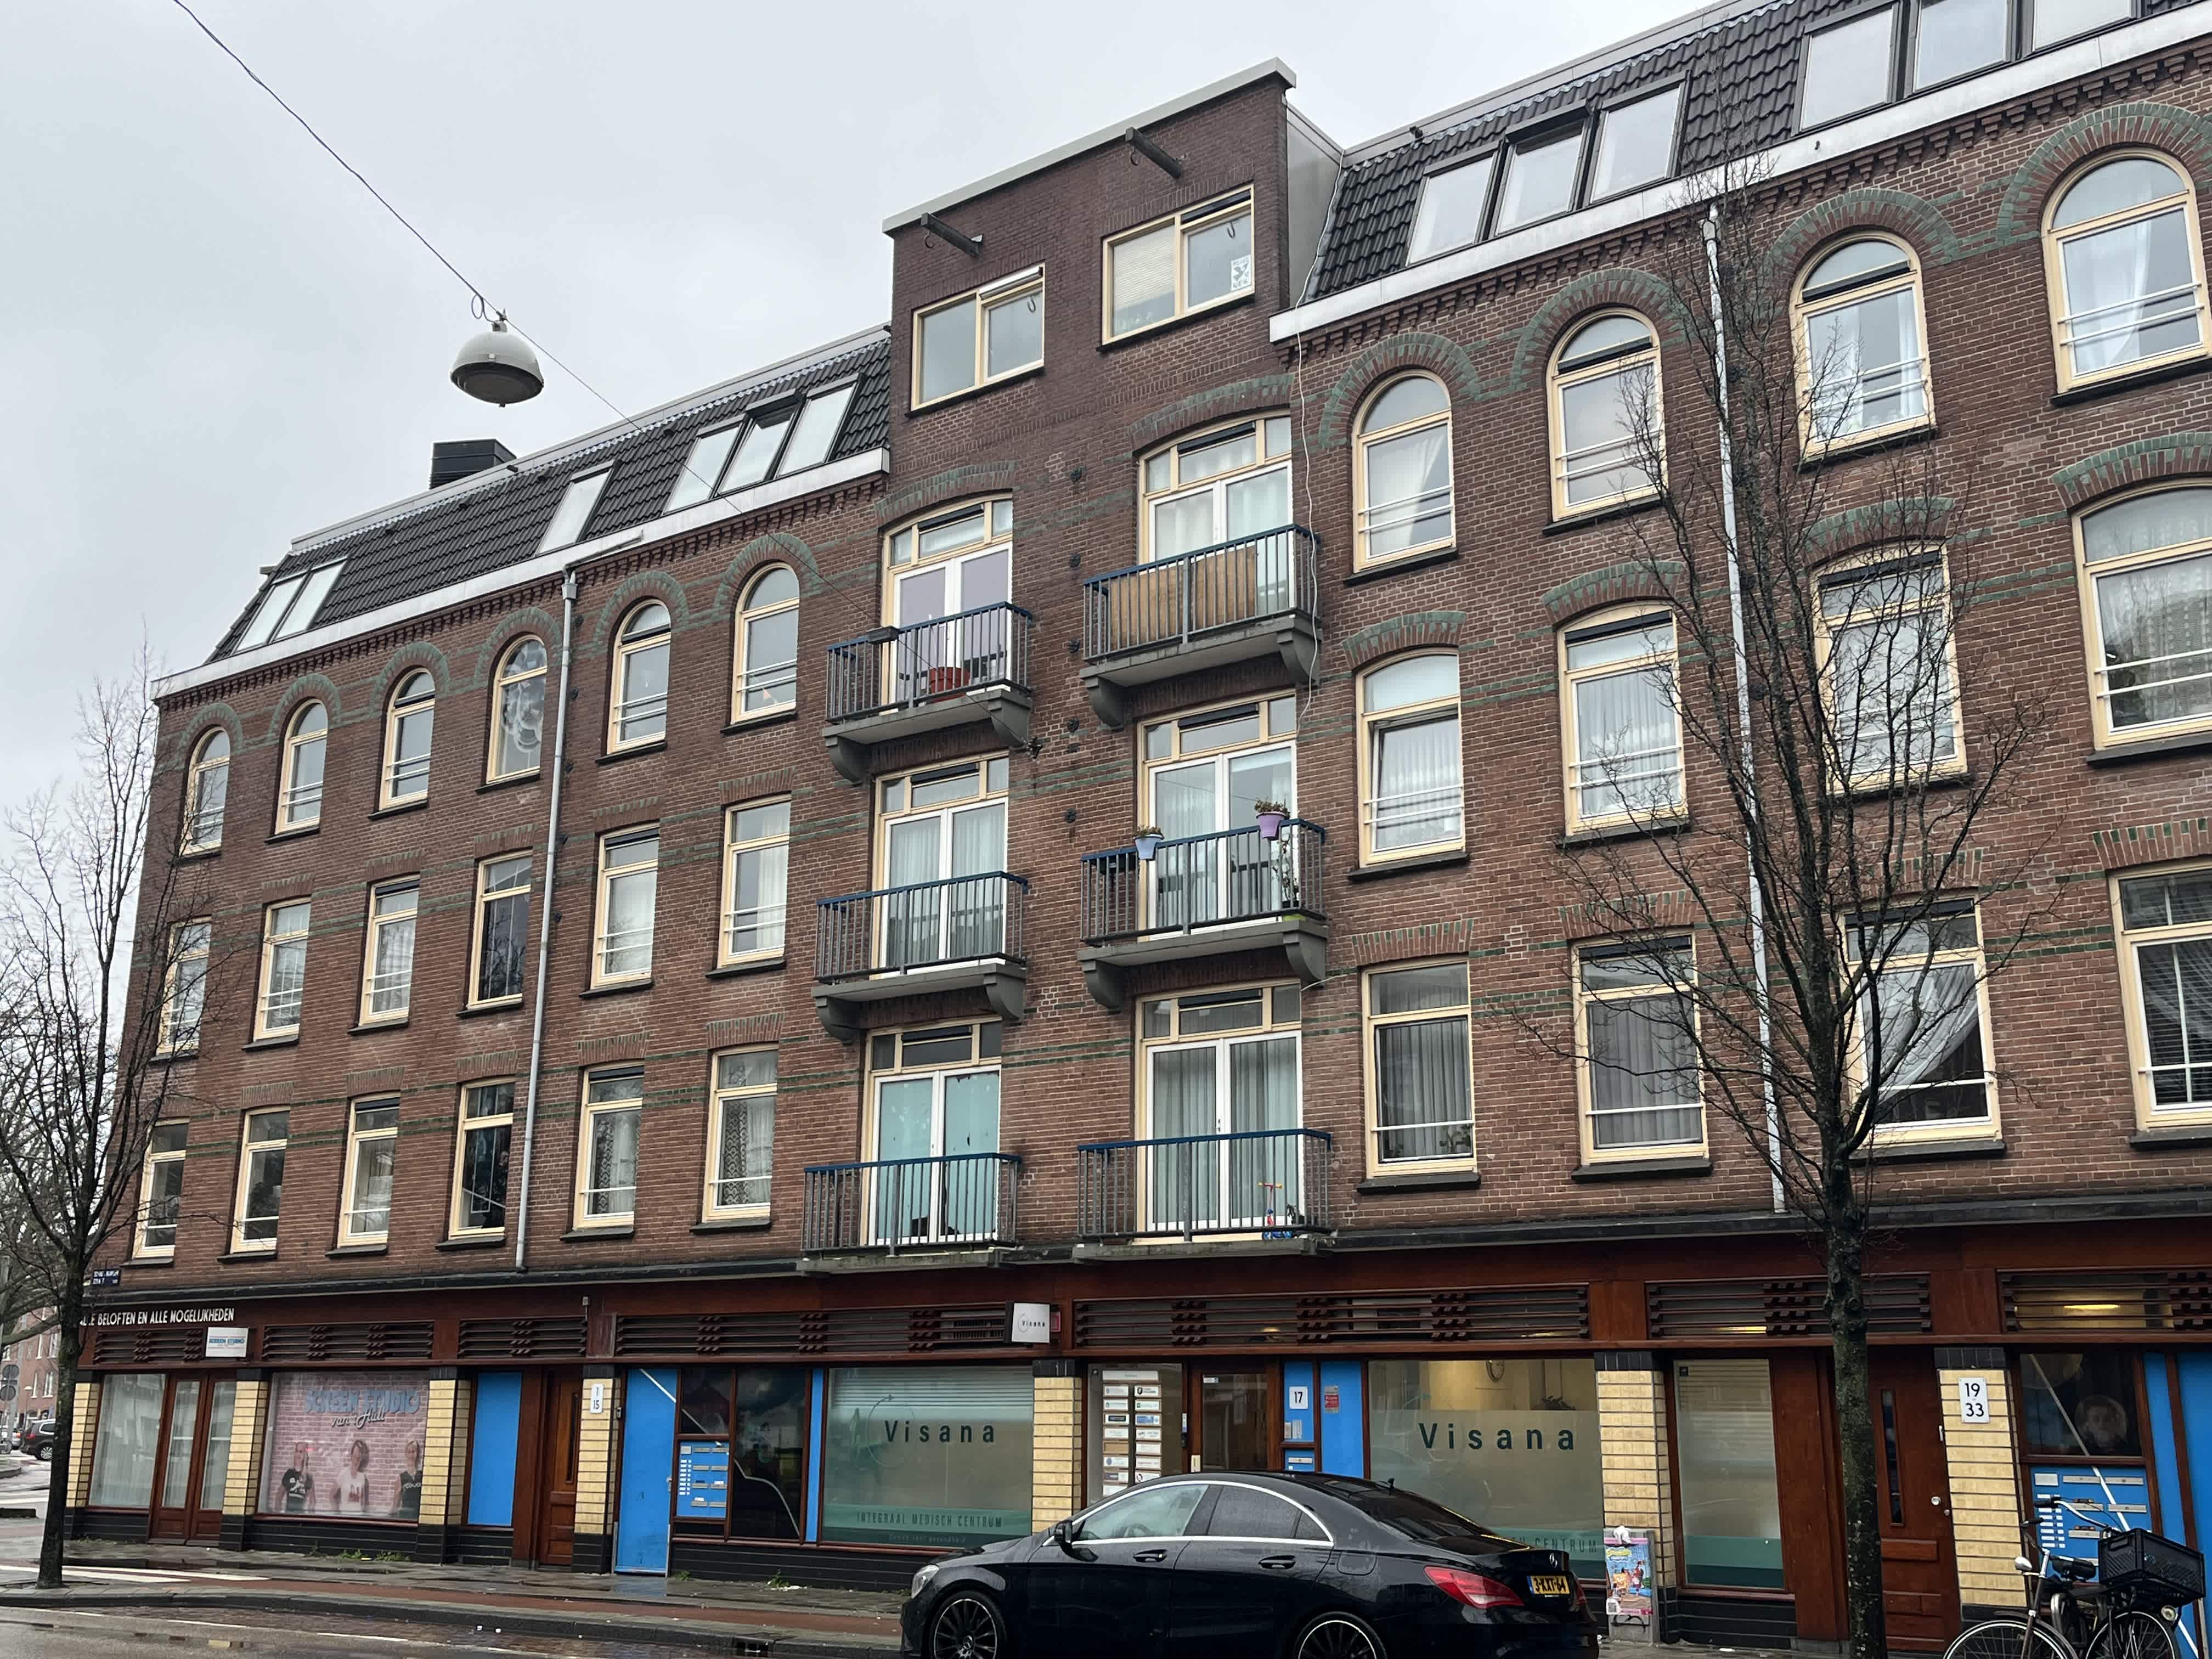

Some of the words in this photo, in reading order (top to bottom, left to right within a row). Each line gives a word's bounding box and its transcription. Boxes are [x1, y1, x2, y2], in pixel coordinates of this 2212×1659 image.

[98, 1312, 136, 1325] BELOFTEN
[138, 1311, 148, 1324] EN
[150, 1310, 168, 1324] ALLE
[170, 1308, 235, 1323] MOGELIJKHEDEN
[1294, 1391, 1303, 1404] 17
[1965, 1383, 1980, 1397] 19
[305, 1389, 360, 1414] SCREEN
[363, 1389, 421, 1414] STUDIO
[593, 1400, 600, 1409] 15
[1965, 1403, 1984, 1417] 33
[884, 1420, 994, 1443] Visana
[1418, 1423, 1574, 1450] Visana
[857, 1511, 905, 1525] INTEGRAAL
[912, 1514, 952, 1527] MEDISCH
[957, 1515, 1002, 1528] CENTRUM
